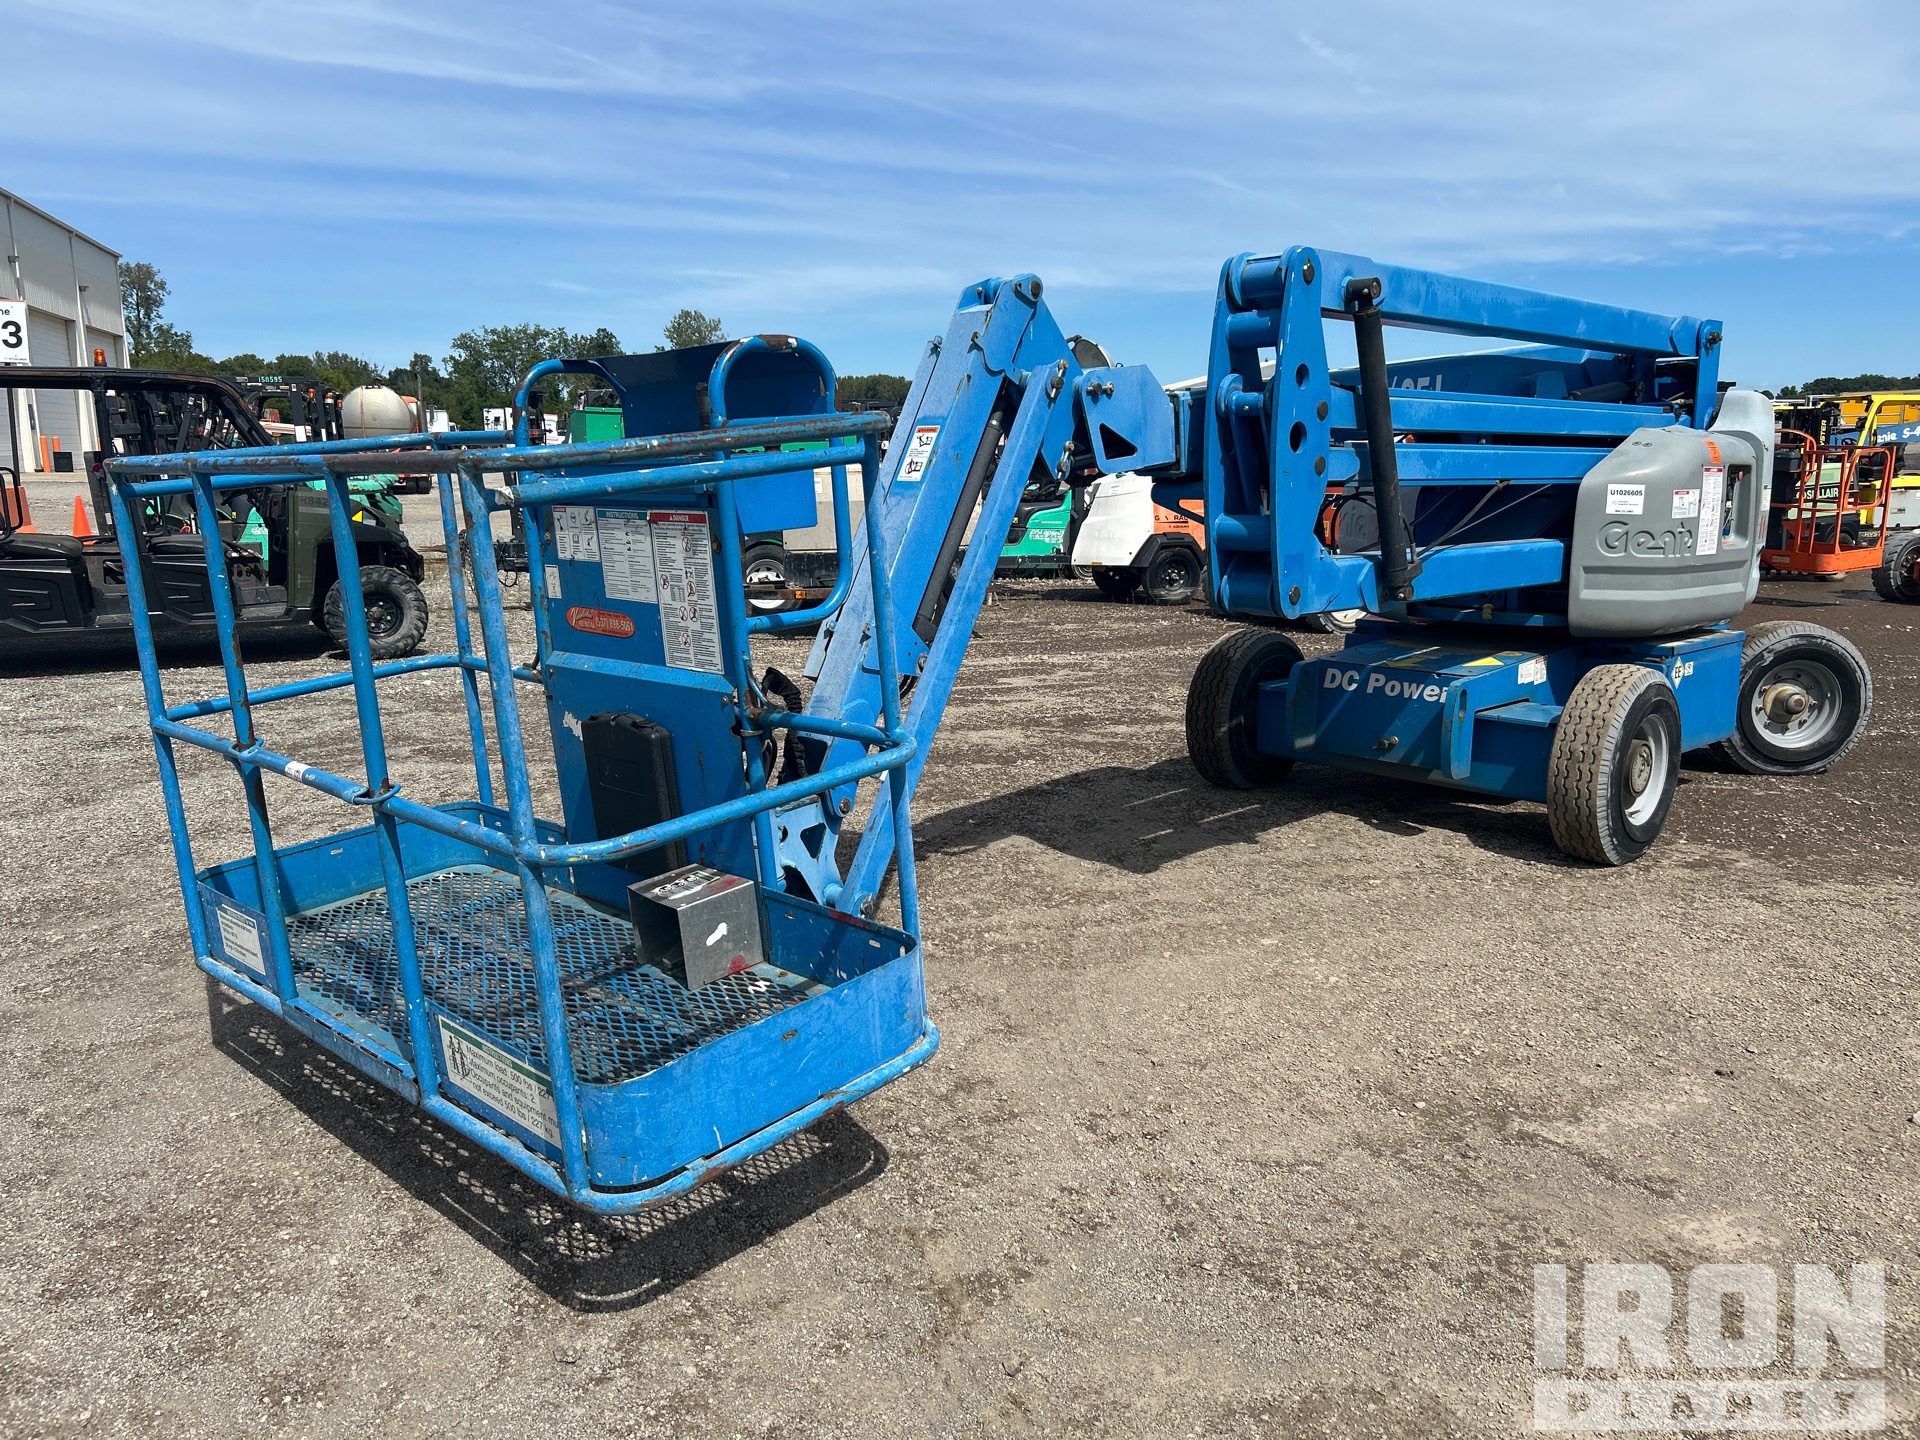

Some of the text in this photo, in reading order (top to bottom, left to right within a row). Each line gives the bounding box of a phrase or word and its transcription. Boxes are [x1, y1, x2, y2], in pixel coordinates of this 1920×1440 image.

[1, 320, 23, 349] 3
[1819, 420, 1827, 446] YSTER
[1876, 432, 1898, 443] enie
[1675, 665, 1682, 679] EE
[1323, 667, 1448, 704] DC Power
[466, 1045, 493, 1067] Maximum
[468, 1057, 496, 1079] Maximum
[470, 1069, 500, 1094] Occupants
[514, 1096, 546, 1122] equipment
[483, 1087, 503, 1105] exceed
[504, 1101, 516, 1113] 500
